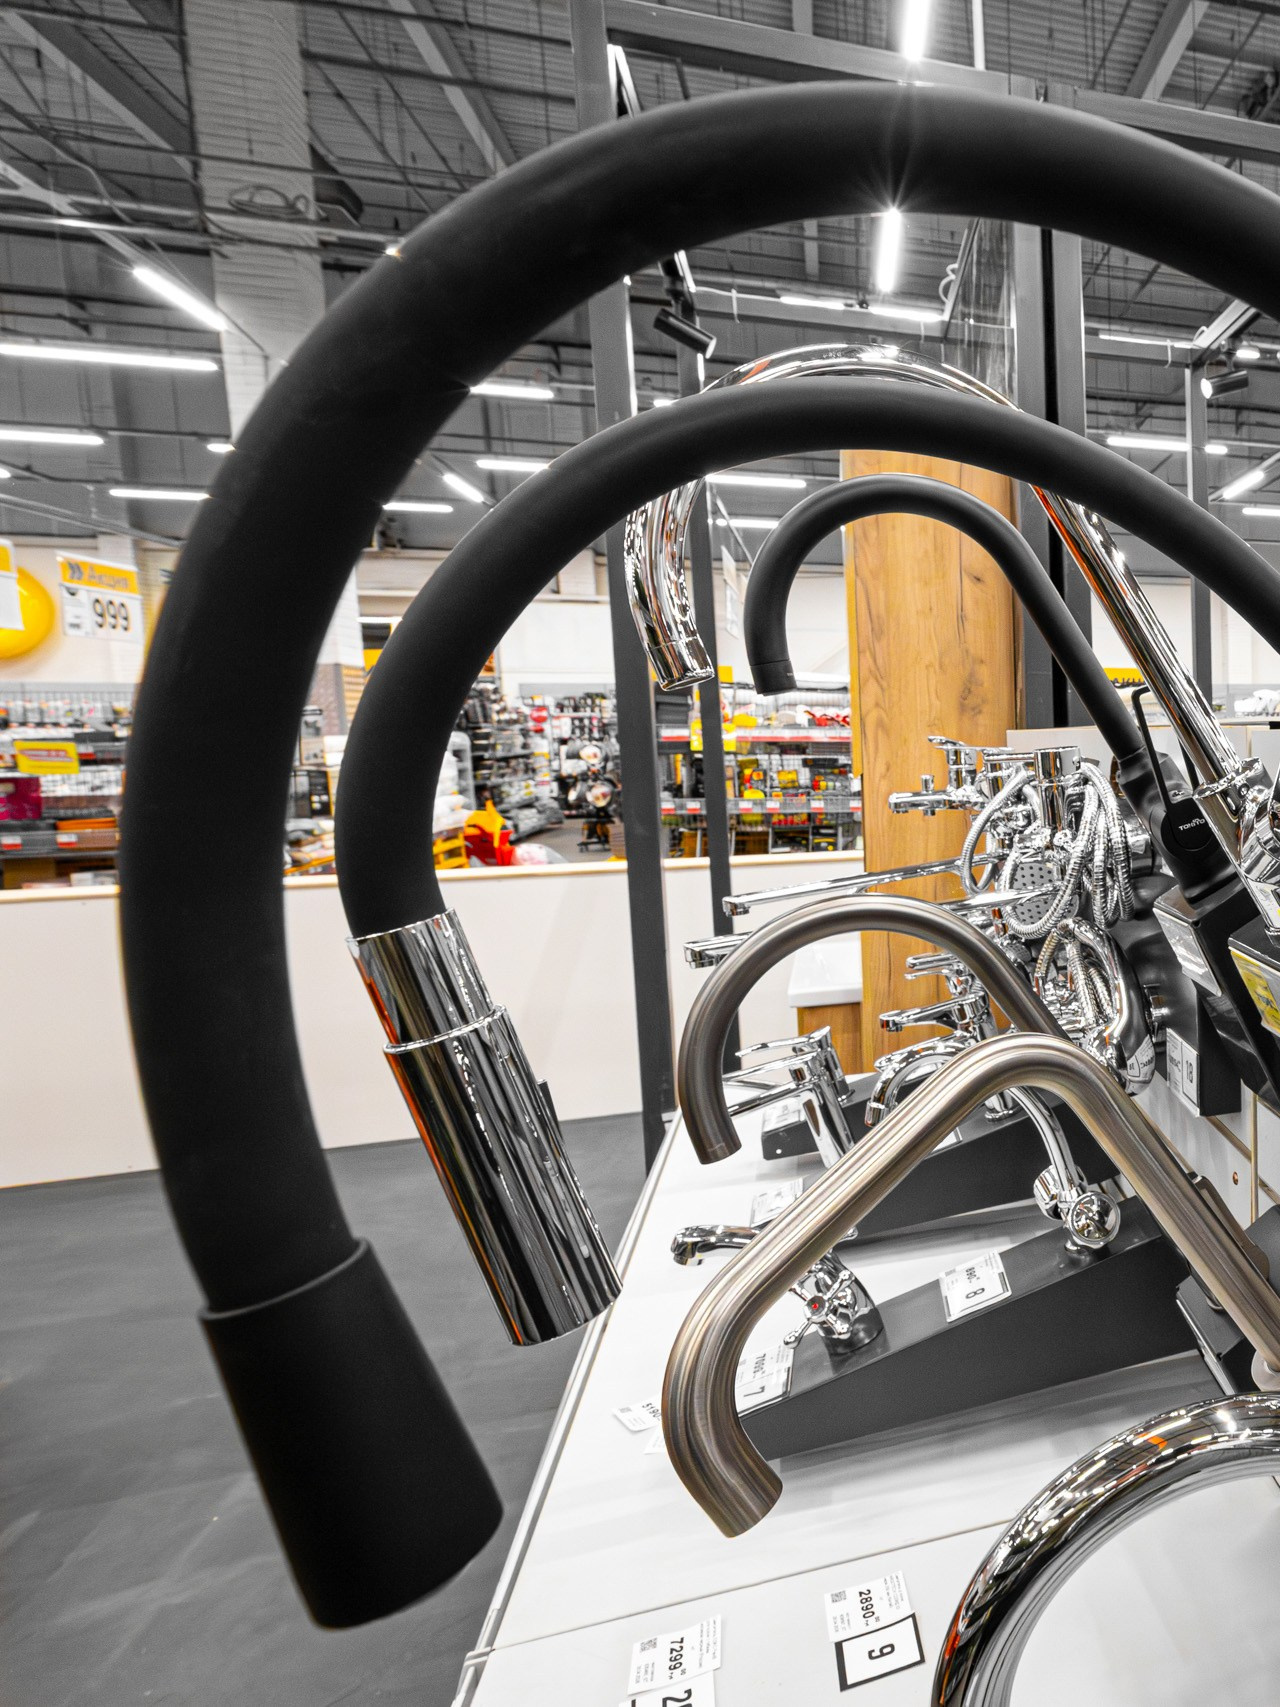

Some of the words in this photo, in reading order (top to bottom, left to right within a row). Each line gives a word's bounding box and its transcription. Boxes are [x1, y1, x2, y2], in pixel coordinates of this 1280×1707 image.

[92, 598, 129, 632] 999
[965, 1287, 986, 1299] 8
[743, 1385, 765, 1398] 7
[859, 1589, 875, 1619] 2890
[668, 1637, 684, 1671] 7299
[868, 1643, 895, 1661] 9
